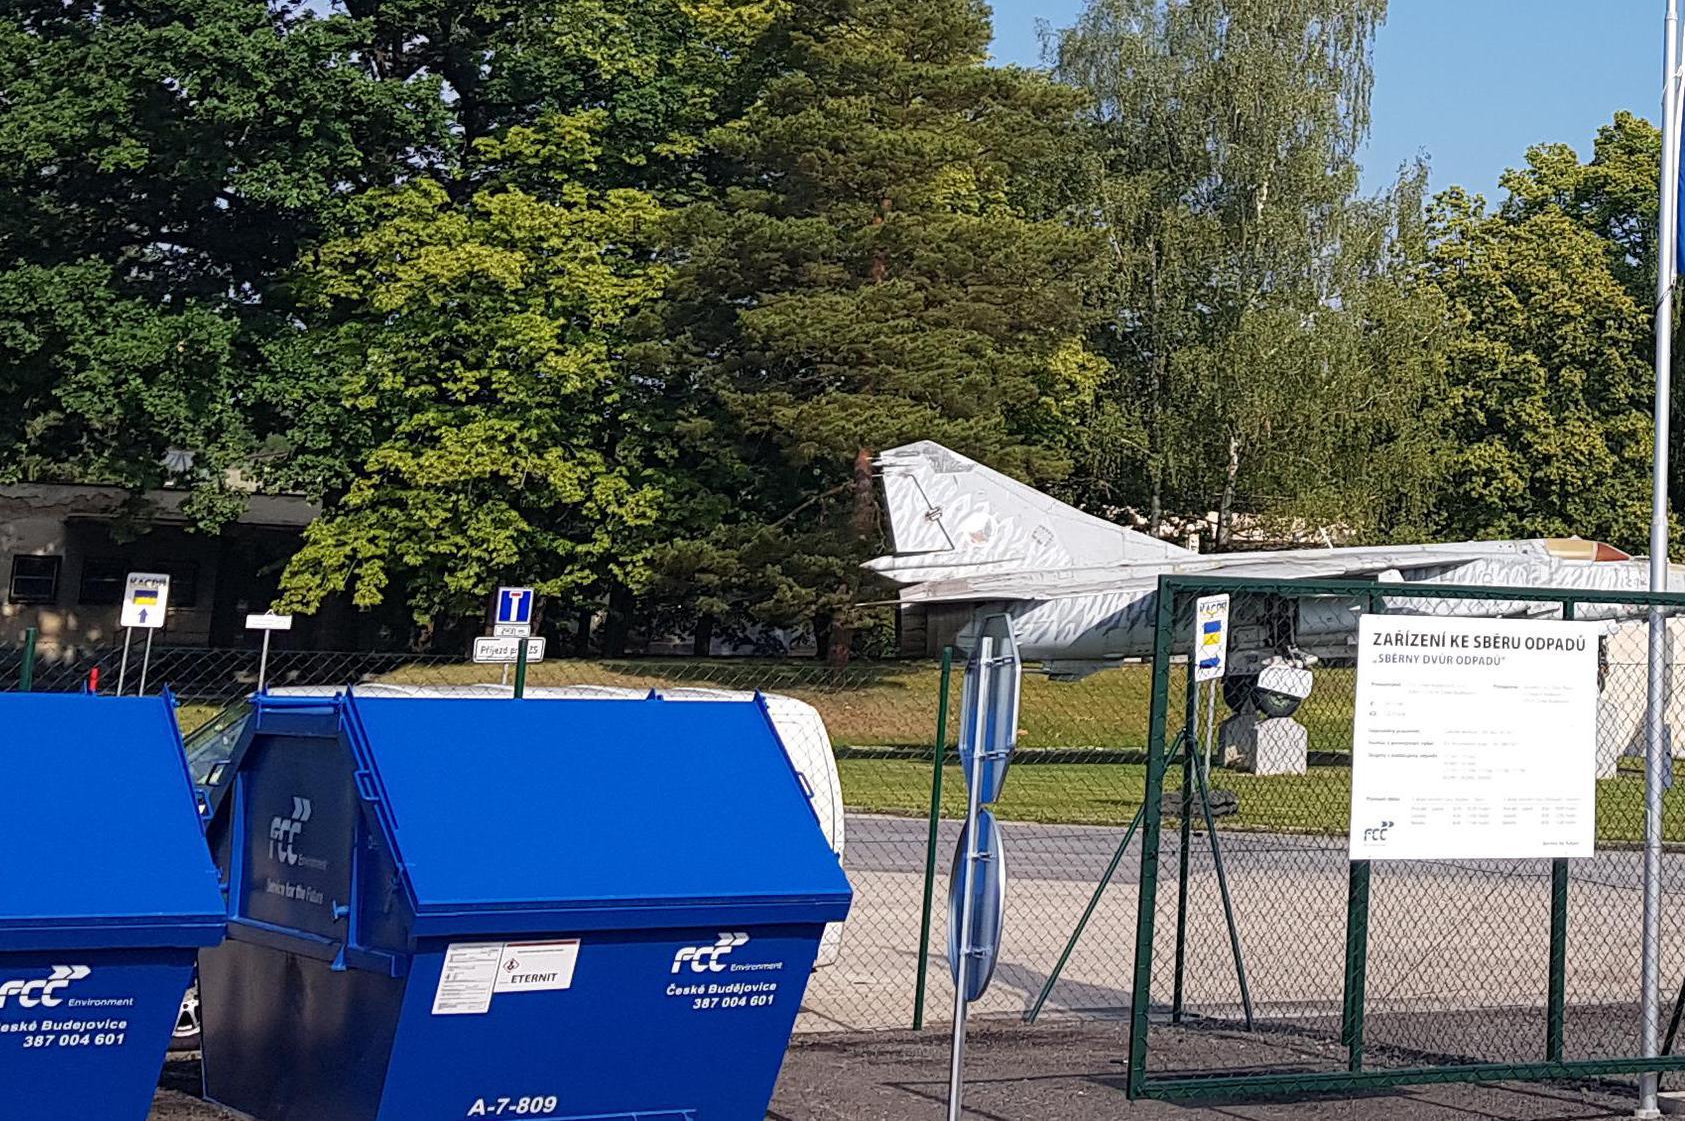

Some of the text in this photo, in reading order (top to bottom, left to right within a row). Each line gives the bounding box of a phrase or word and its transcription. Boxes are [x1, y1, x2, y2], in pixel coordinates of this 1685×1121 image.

[1372, 630, 1586, 652] ZAŘÍZENÍ KE SBĚRU ODPADŮ
[1363, 828, 1388, 841] FCC
[671, 945, 733, 974] FCC
[511, 972, 558, 984] ETERNIT
[0, 979, 70, 1009] FCC
[666, 982, 705, 996] České
[68, 997, 134, 1007] Environment
[692, 994, 775, 1010] 387 004 601
[0, 1020, 38, 1033] eské
[22, 1033, 125, 1048] 387 004 601
[467, 1095, 557, 1117] A-7-809
